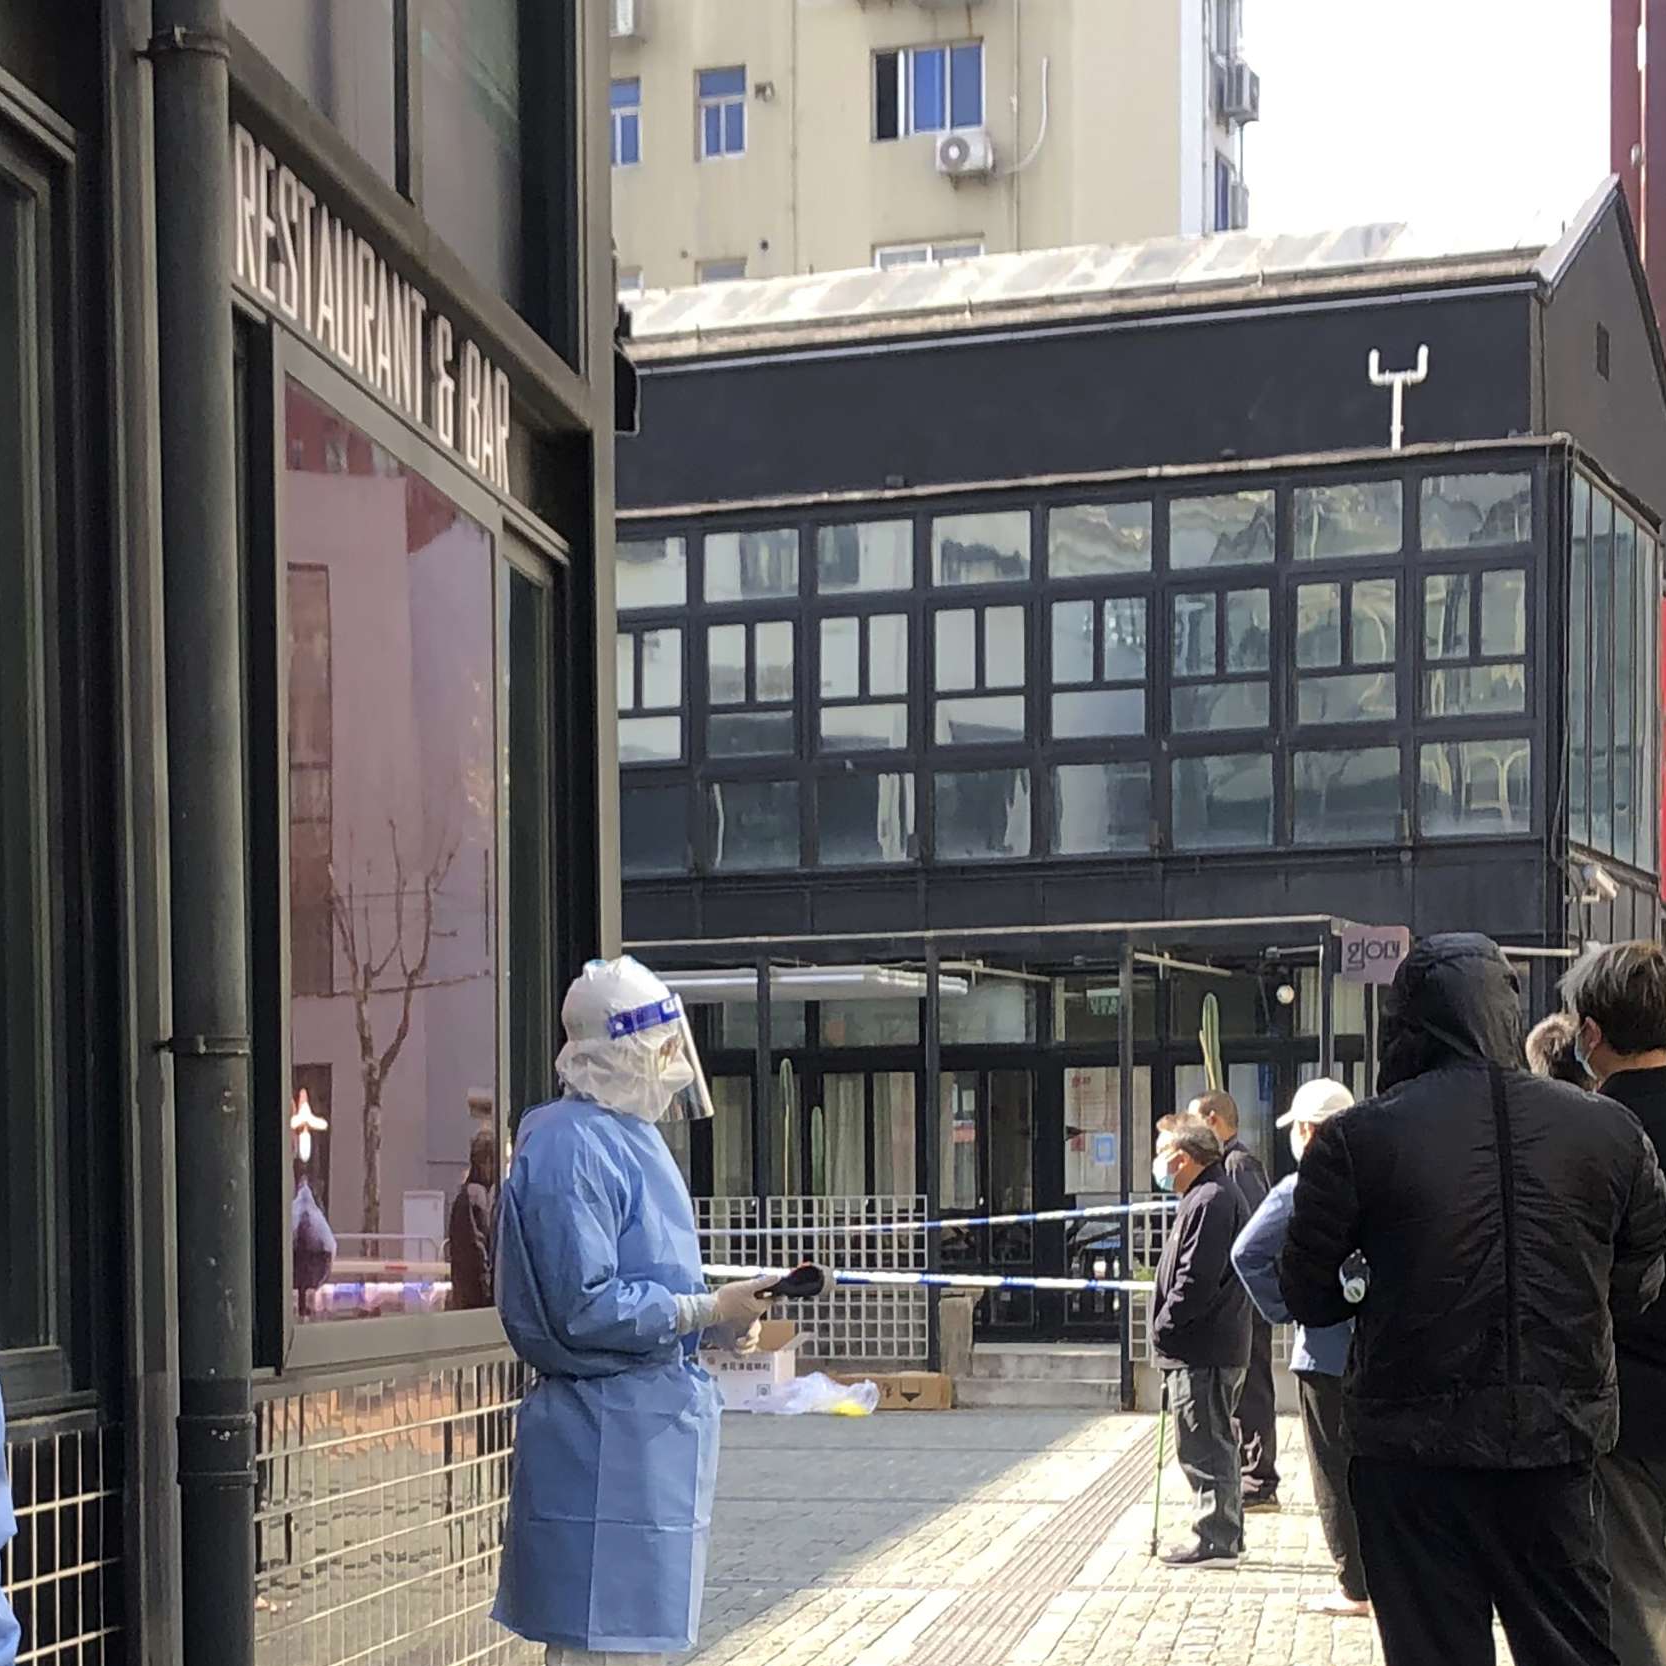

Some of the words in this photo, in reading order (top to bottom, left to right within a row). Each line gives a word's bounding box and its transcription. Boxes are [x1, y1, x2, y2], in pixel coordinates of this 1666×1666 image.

[234, 121, 428, 425] RESTAURANT
[434, 313, 455, 449] &
[460, 338, 510, 496] BAR
